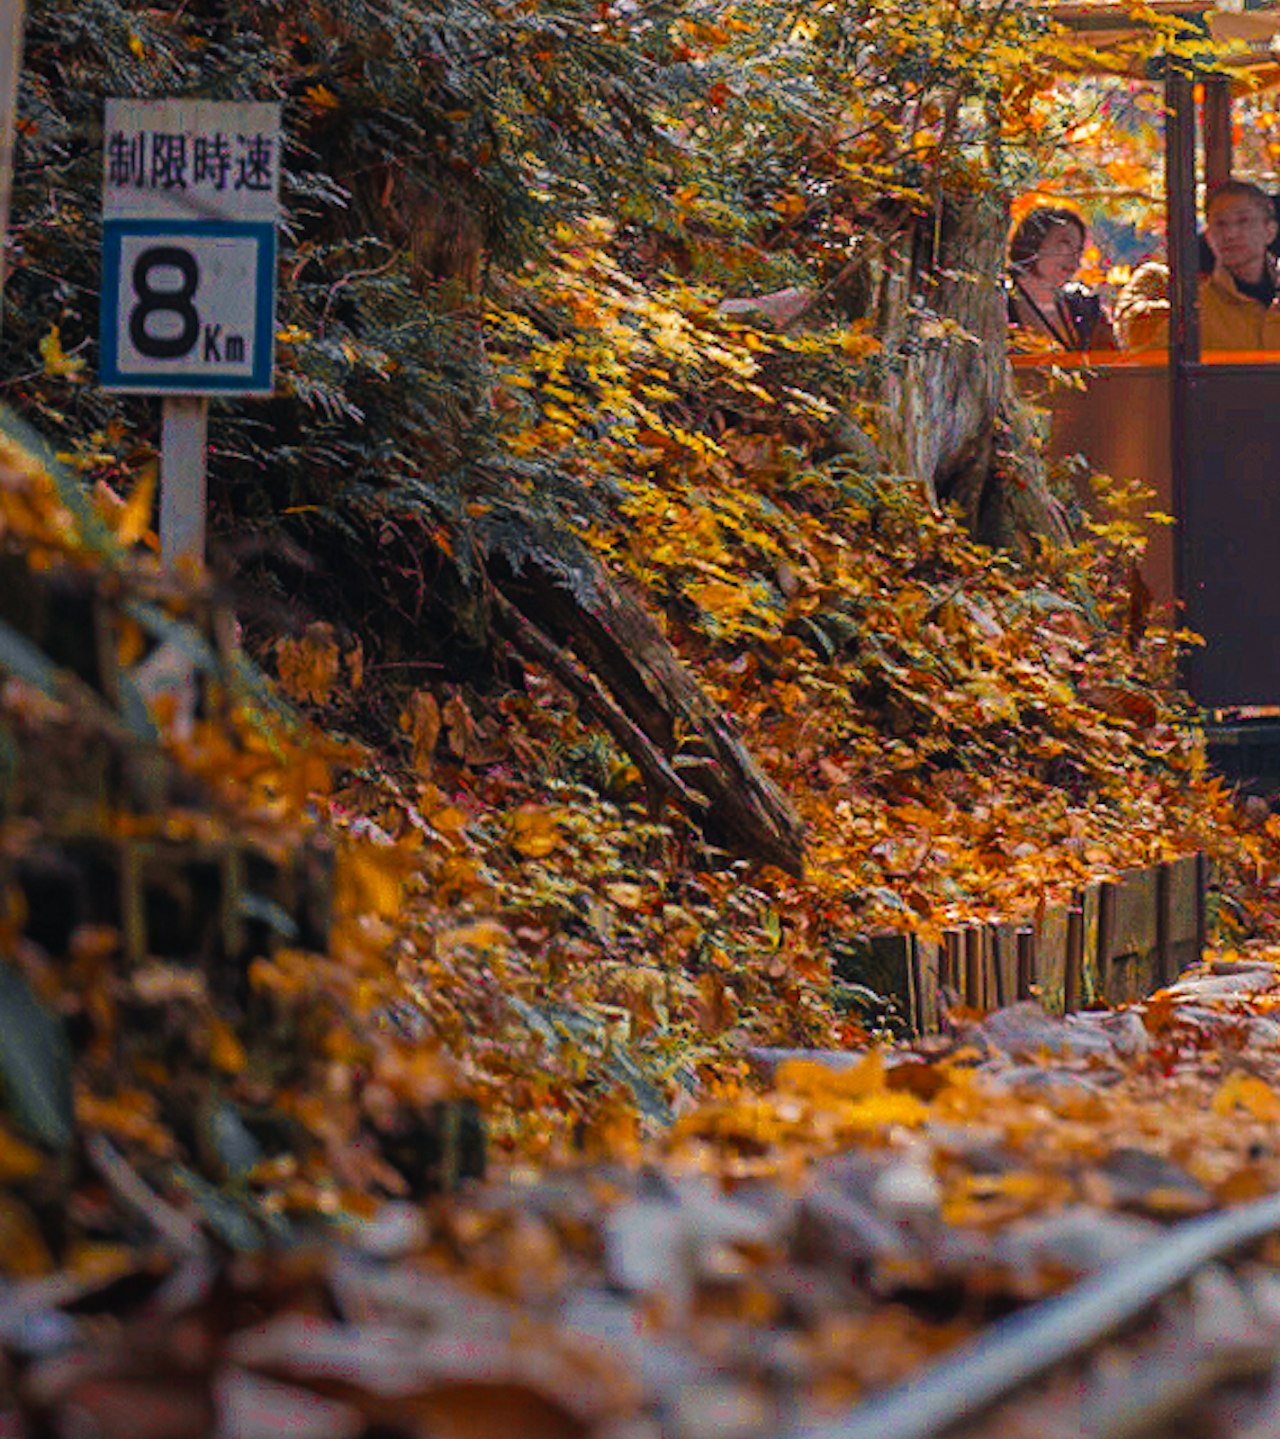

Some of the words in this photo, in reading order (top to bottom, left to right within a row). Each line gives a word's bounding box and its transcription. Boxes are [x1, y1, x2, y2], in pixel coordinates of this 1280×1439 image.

[109, 131, 272, 191] 制限時速
[129, 246, 199, 359] 8
